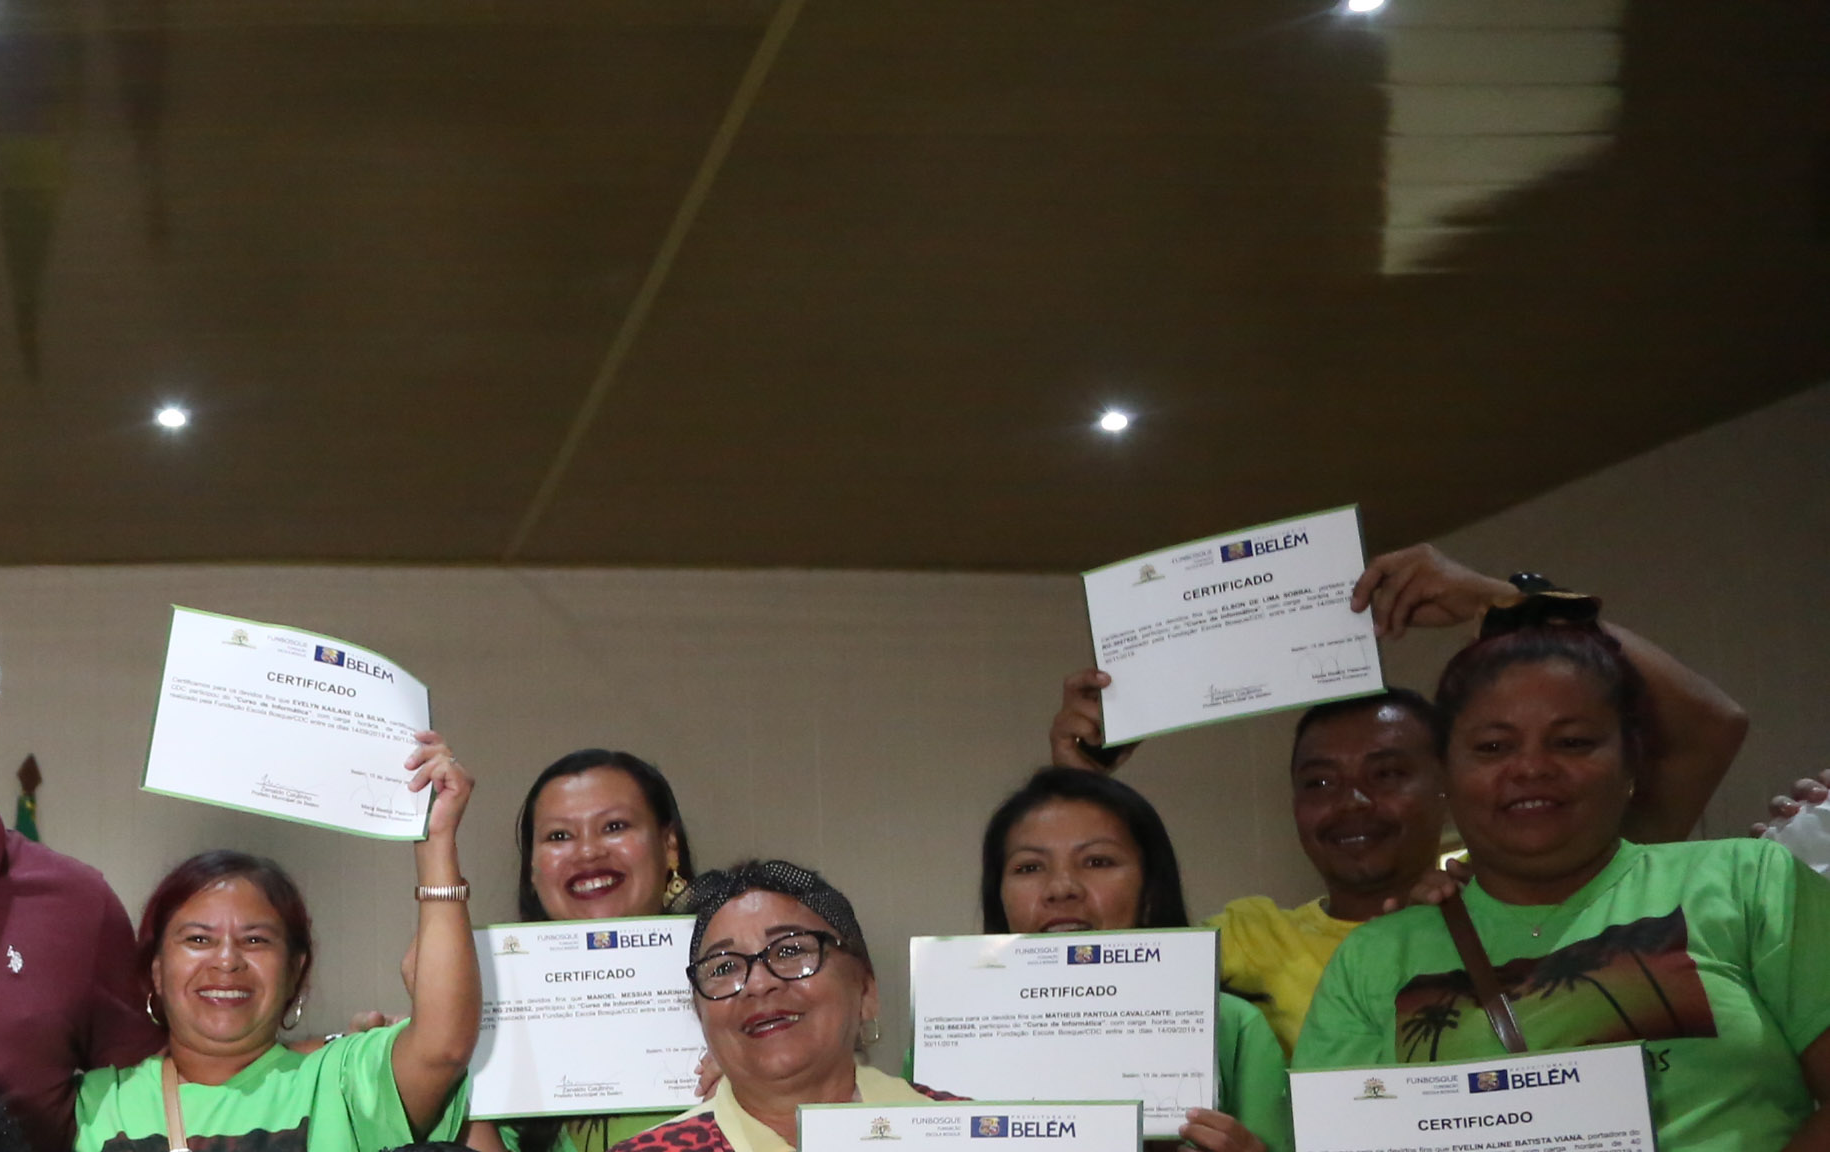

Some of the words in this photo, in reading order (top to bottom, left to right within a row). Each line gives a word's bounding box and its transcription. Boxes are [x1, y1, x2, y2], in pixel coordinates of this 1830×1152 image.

[1255, 533, 1308, 555] BELÉM
[1182, 572, 1273, 601] CERTIFICADO
[346, 658, 393, 682] BELÉM
[266, 671, 356, 697] CERTIFICADO
[619, 932, 673, 948] BELÉM
[1102, 946, 1160, 964] BELÉM
[544, 967, 635, 983] CERTIFICADO
[1019, 985, 1117, 998] CERTIFICADO
[1405, 1074, 1458, 1084] FUNBOSQUE
[1510, 1067, 1580, 1089] BELÉM
[911, 1116, 961, 1124] FUNBOSQUE
[1011, 1120, 1075, 1137] BELÉM
[1417, 1111, 1532, 1131] CERTIFICADO
[1451, 1143, 1483, 1151] EVELIN
[1485, 1140, 1512, 1149] ALINE
[1514, 1136, 1552, 1146] BATISTA
